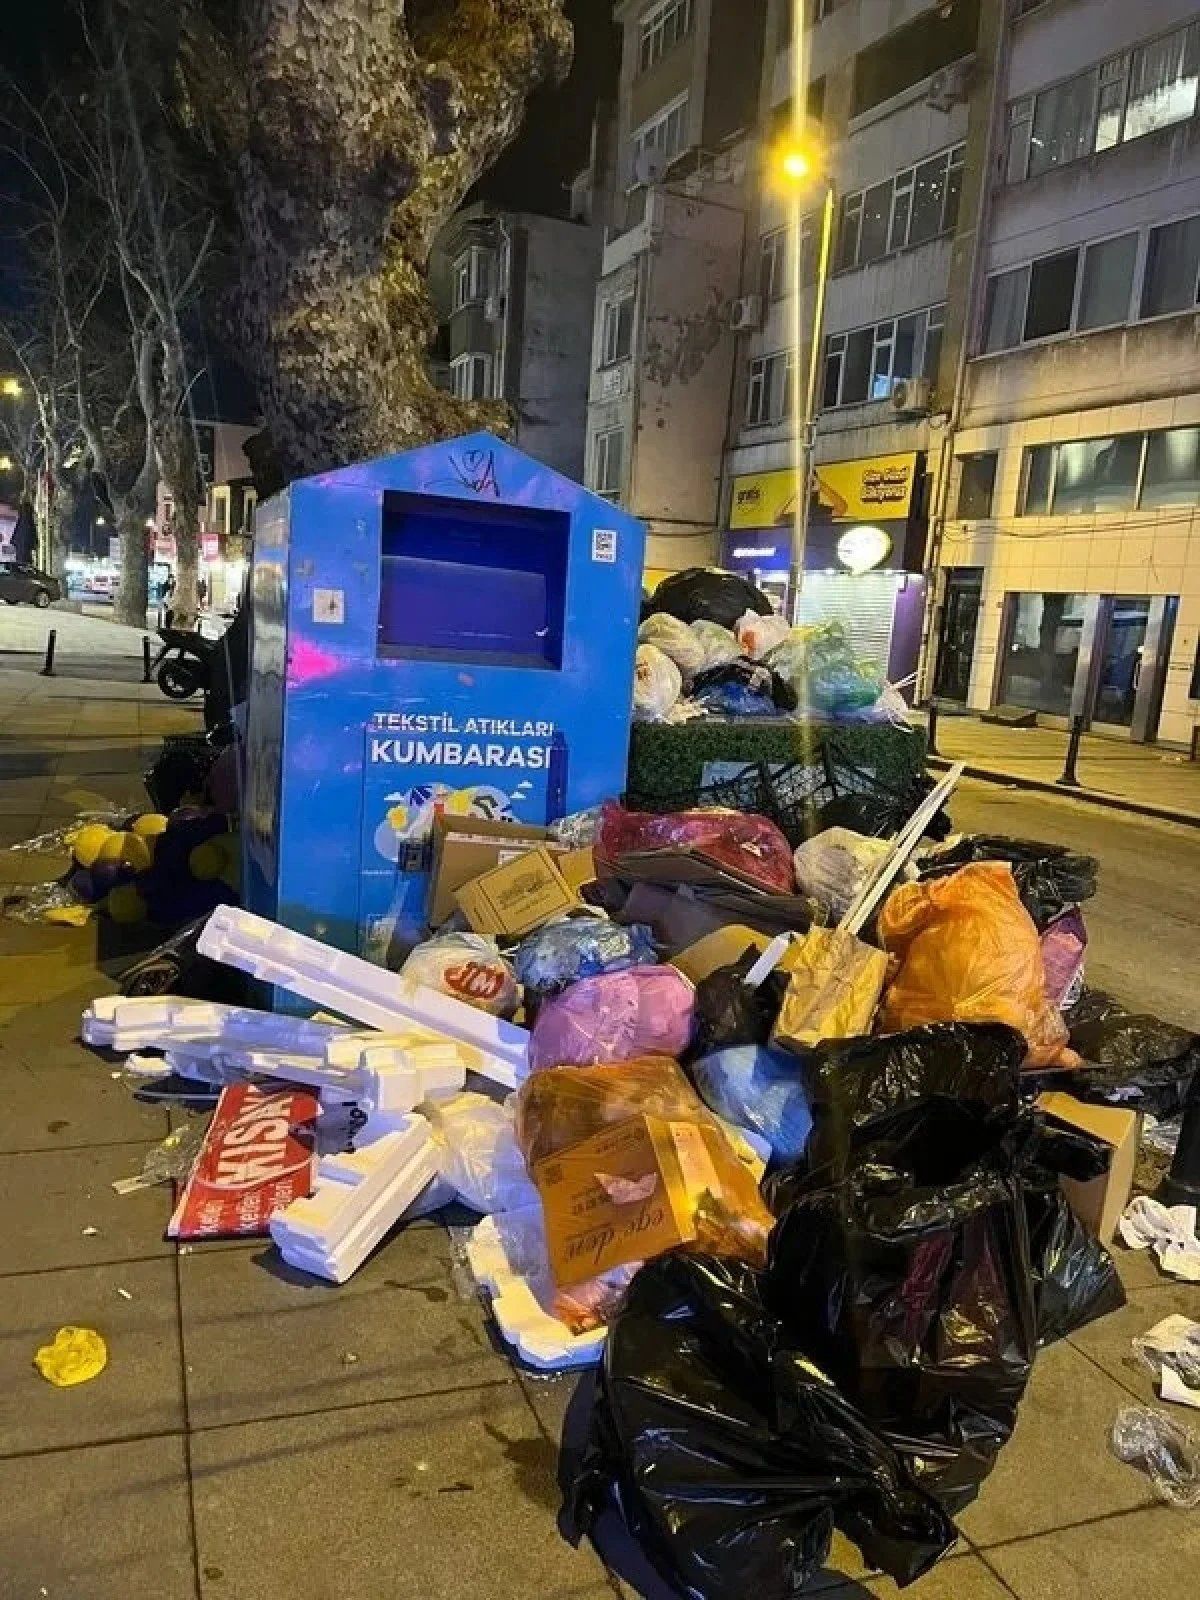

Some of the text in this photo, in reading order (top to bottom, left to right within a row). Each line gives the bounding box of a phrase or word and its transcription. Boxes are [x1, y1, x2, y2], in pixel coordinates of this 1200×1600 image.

[373, 711, 555, 737] TEKSTİL ATIKLARI
[371, 739, 551, 769] KUMBARASI
